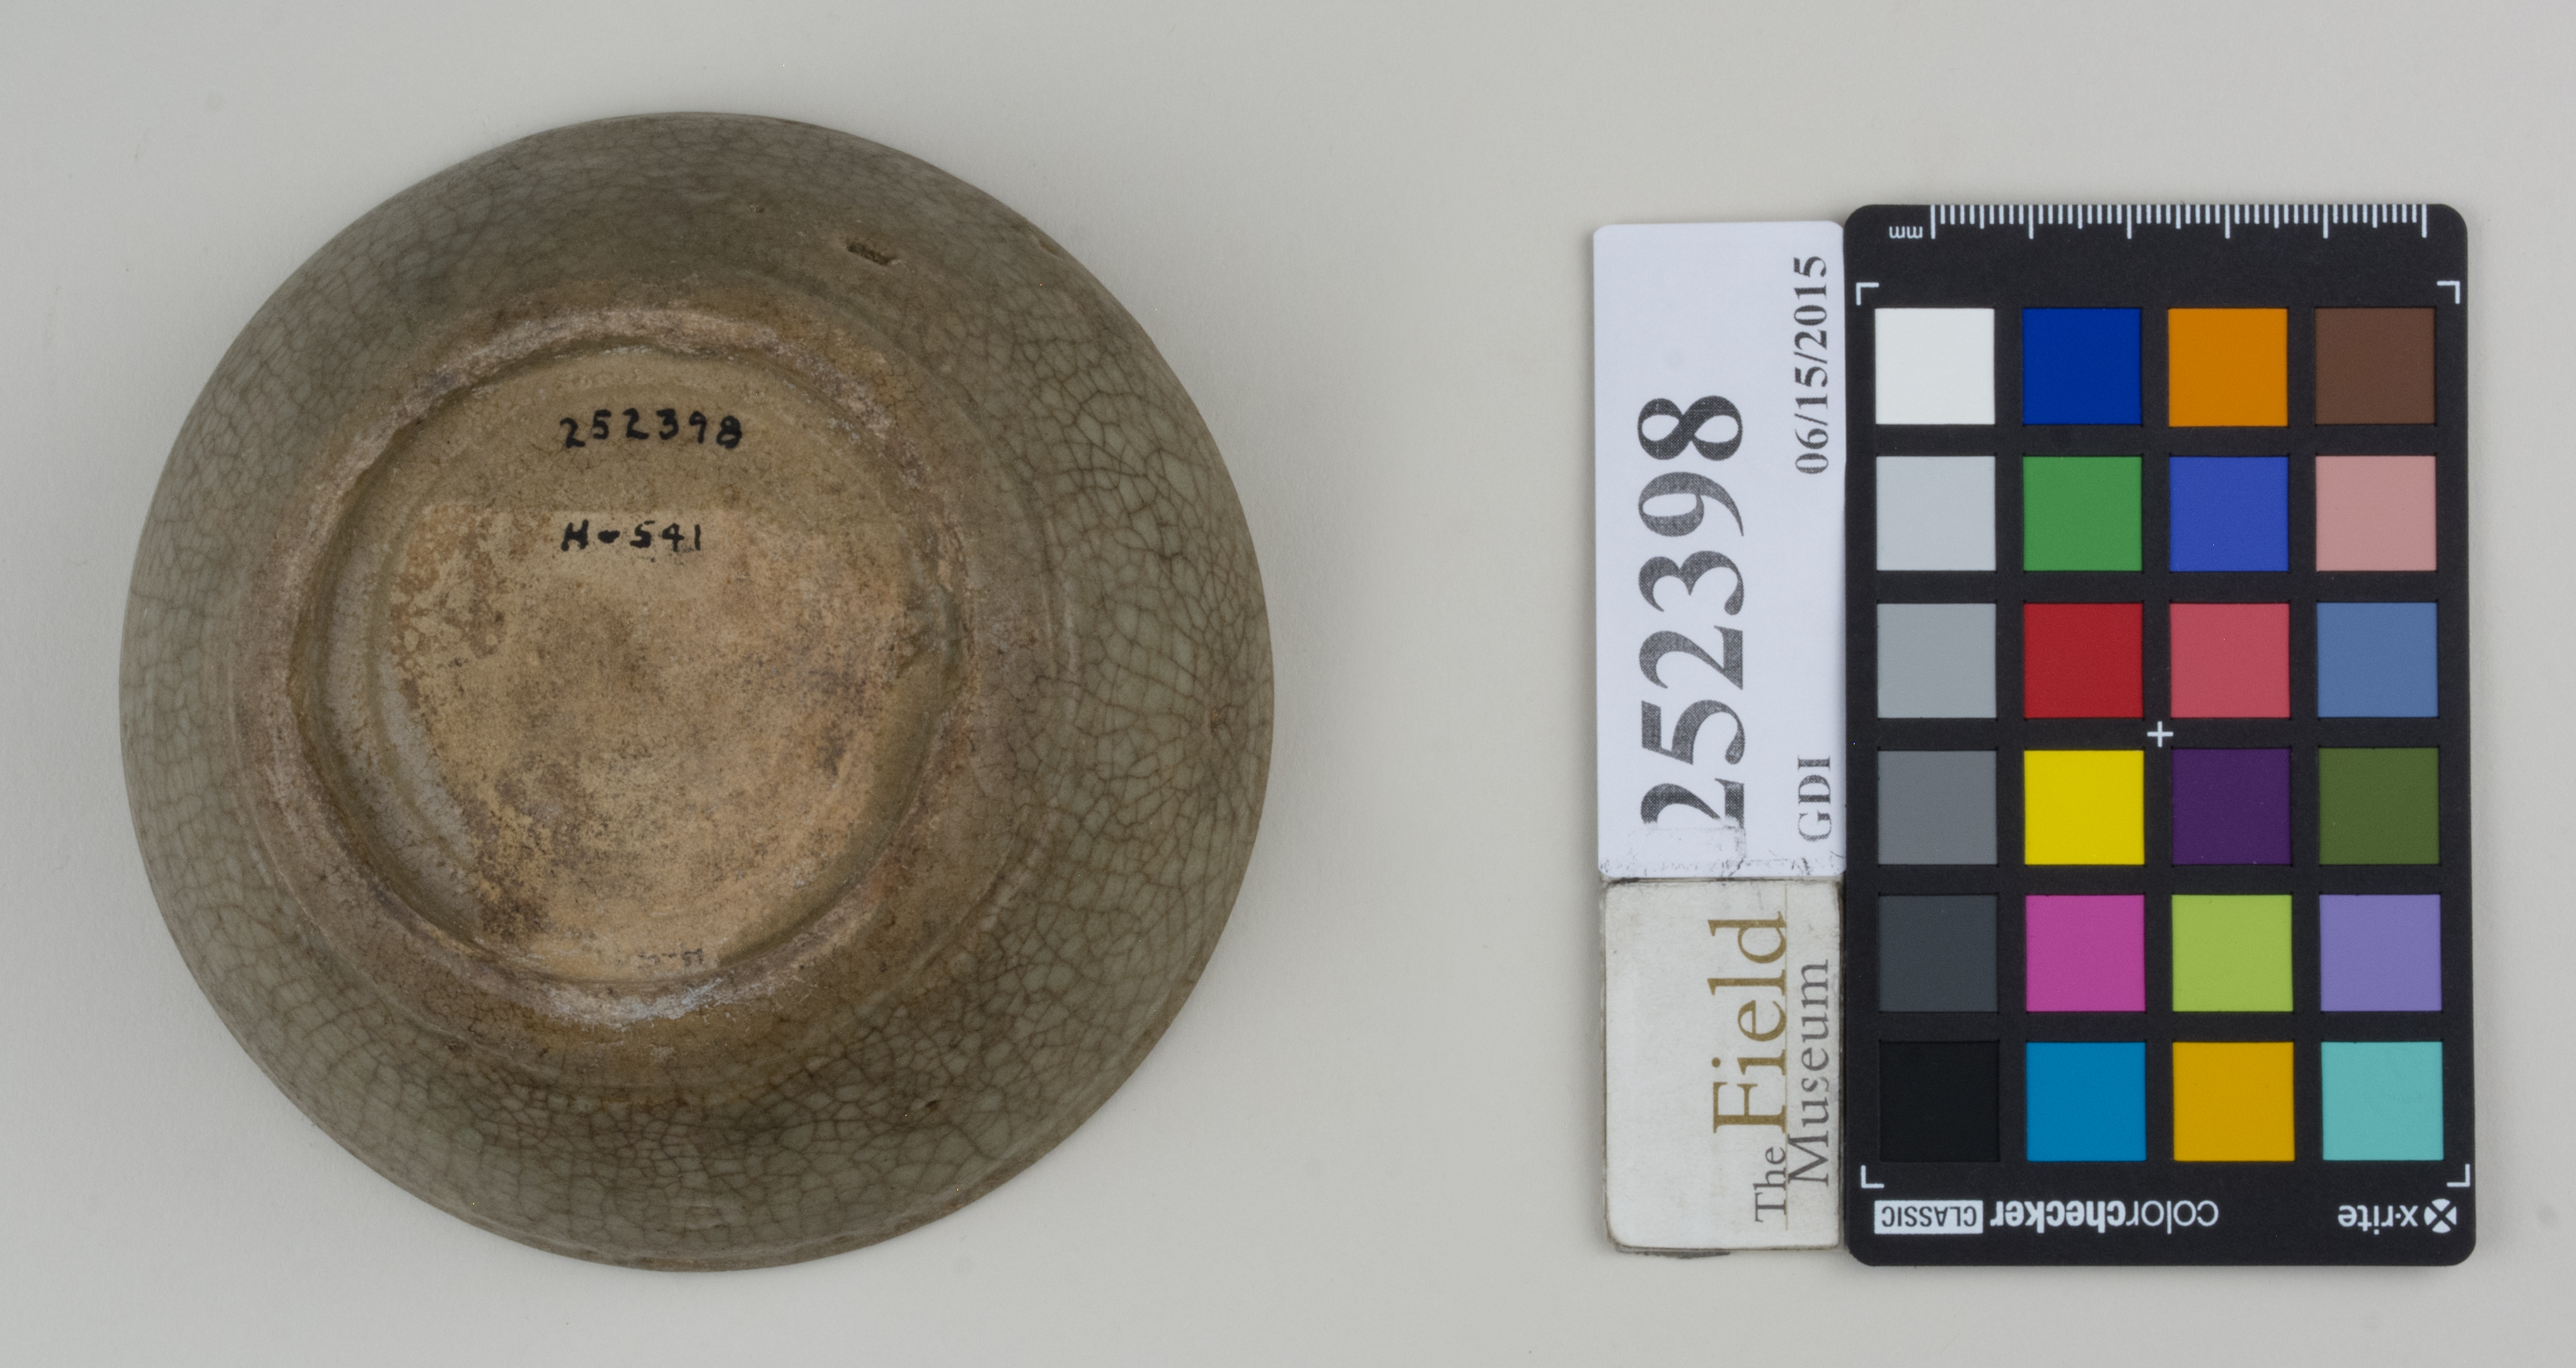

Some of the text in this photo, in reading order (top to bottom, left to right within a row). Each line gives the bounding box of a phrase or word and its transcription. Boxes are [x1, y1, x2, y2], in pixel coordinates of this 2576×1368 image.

[1888, 226, 1923, 239] mm
[1793, 255, 1830, 475] 06/15/2015
[559, 407, 743, 449] 252398
[560, 519, 702, 553] H-541
[1637, 395, 1745, 829] 252398
[1798, 756, 1832, 842] GDI
[1707, 911, 1786, 1223] The Field
[1787, 959, 1830, 1188] Museum
[1881, 1200, 2219, 1234] colorchecker CLASSIC
